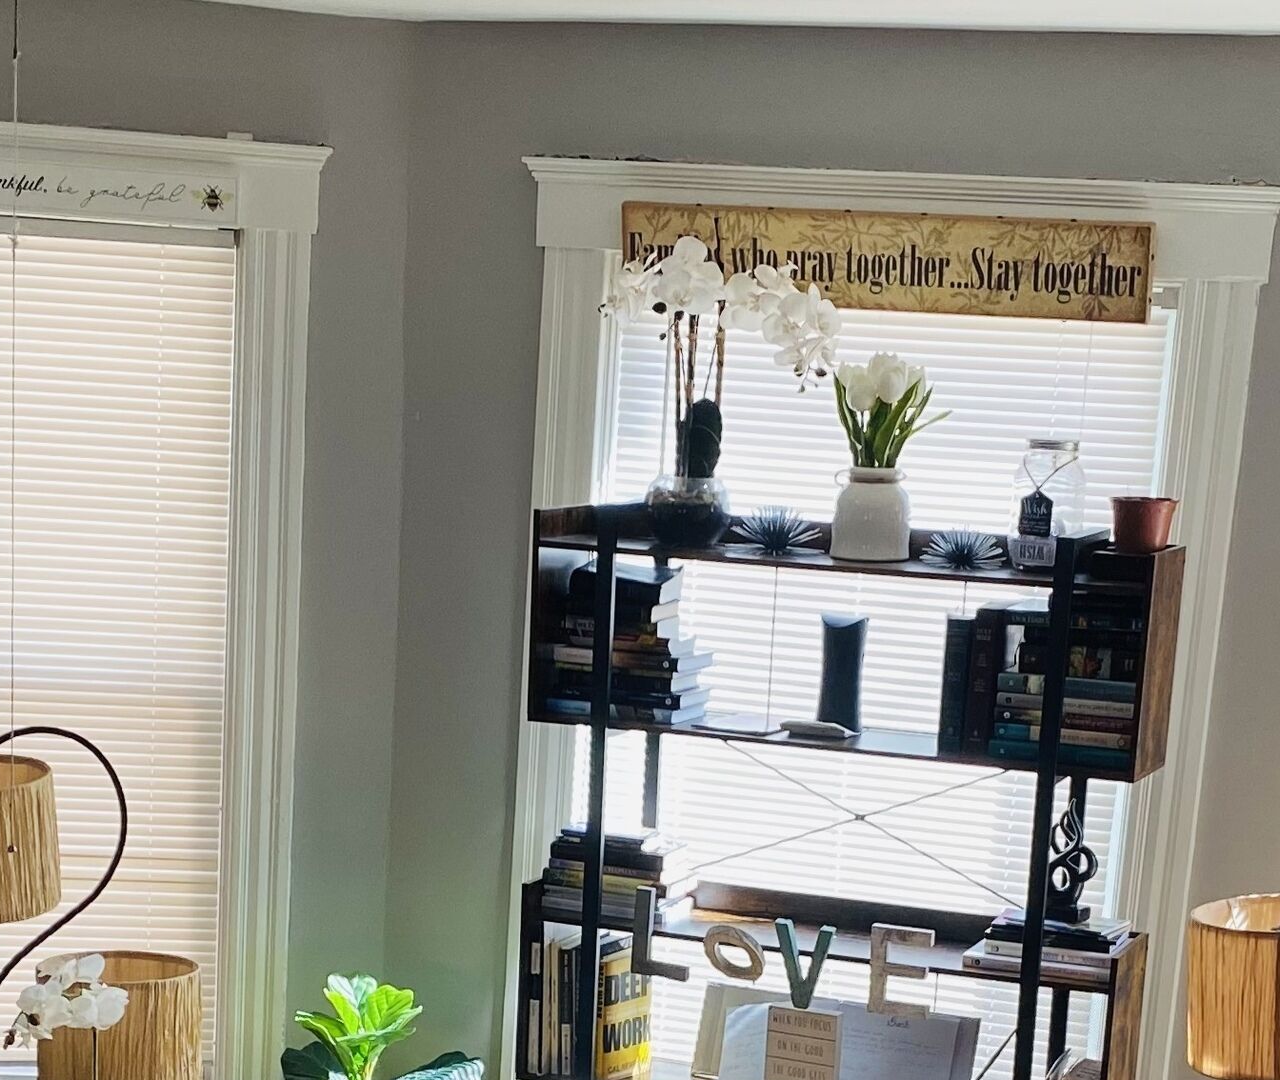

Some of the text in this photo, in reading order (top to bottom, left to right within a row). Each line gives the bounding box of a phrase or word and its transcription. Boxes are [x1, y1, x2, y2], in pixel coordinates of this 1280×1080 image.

[56, 176, 80, 194] be
[80, 182, 187, 211] grateful
[1032, 251, 1143, 304] together
[631, 885, 936, 1020] LOVE
[604, 971, 652, 1006] DEEP
[603, 1013, 652, 1054] WORK
[810, 1016, 832, 1032] FOCUS
[777, 1039, 787, 1050] ON
[804, 1044, 824, 1057] GOOD
[787, 1066, 806, 1079] GOOD
